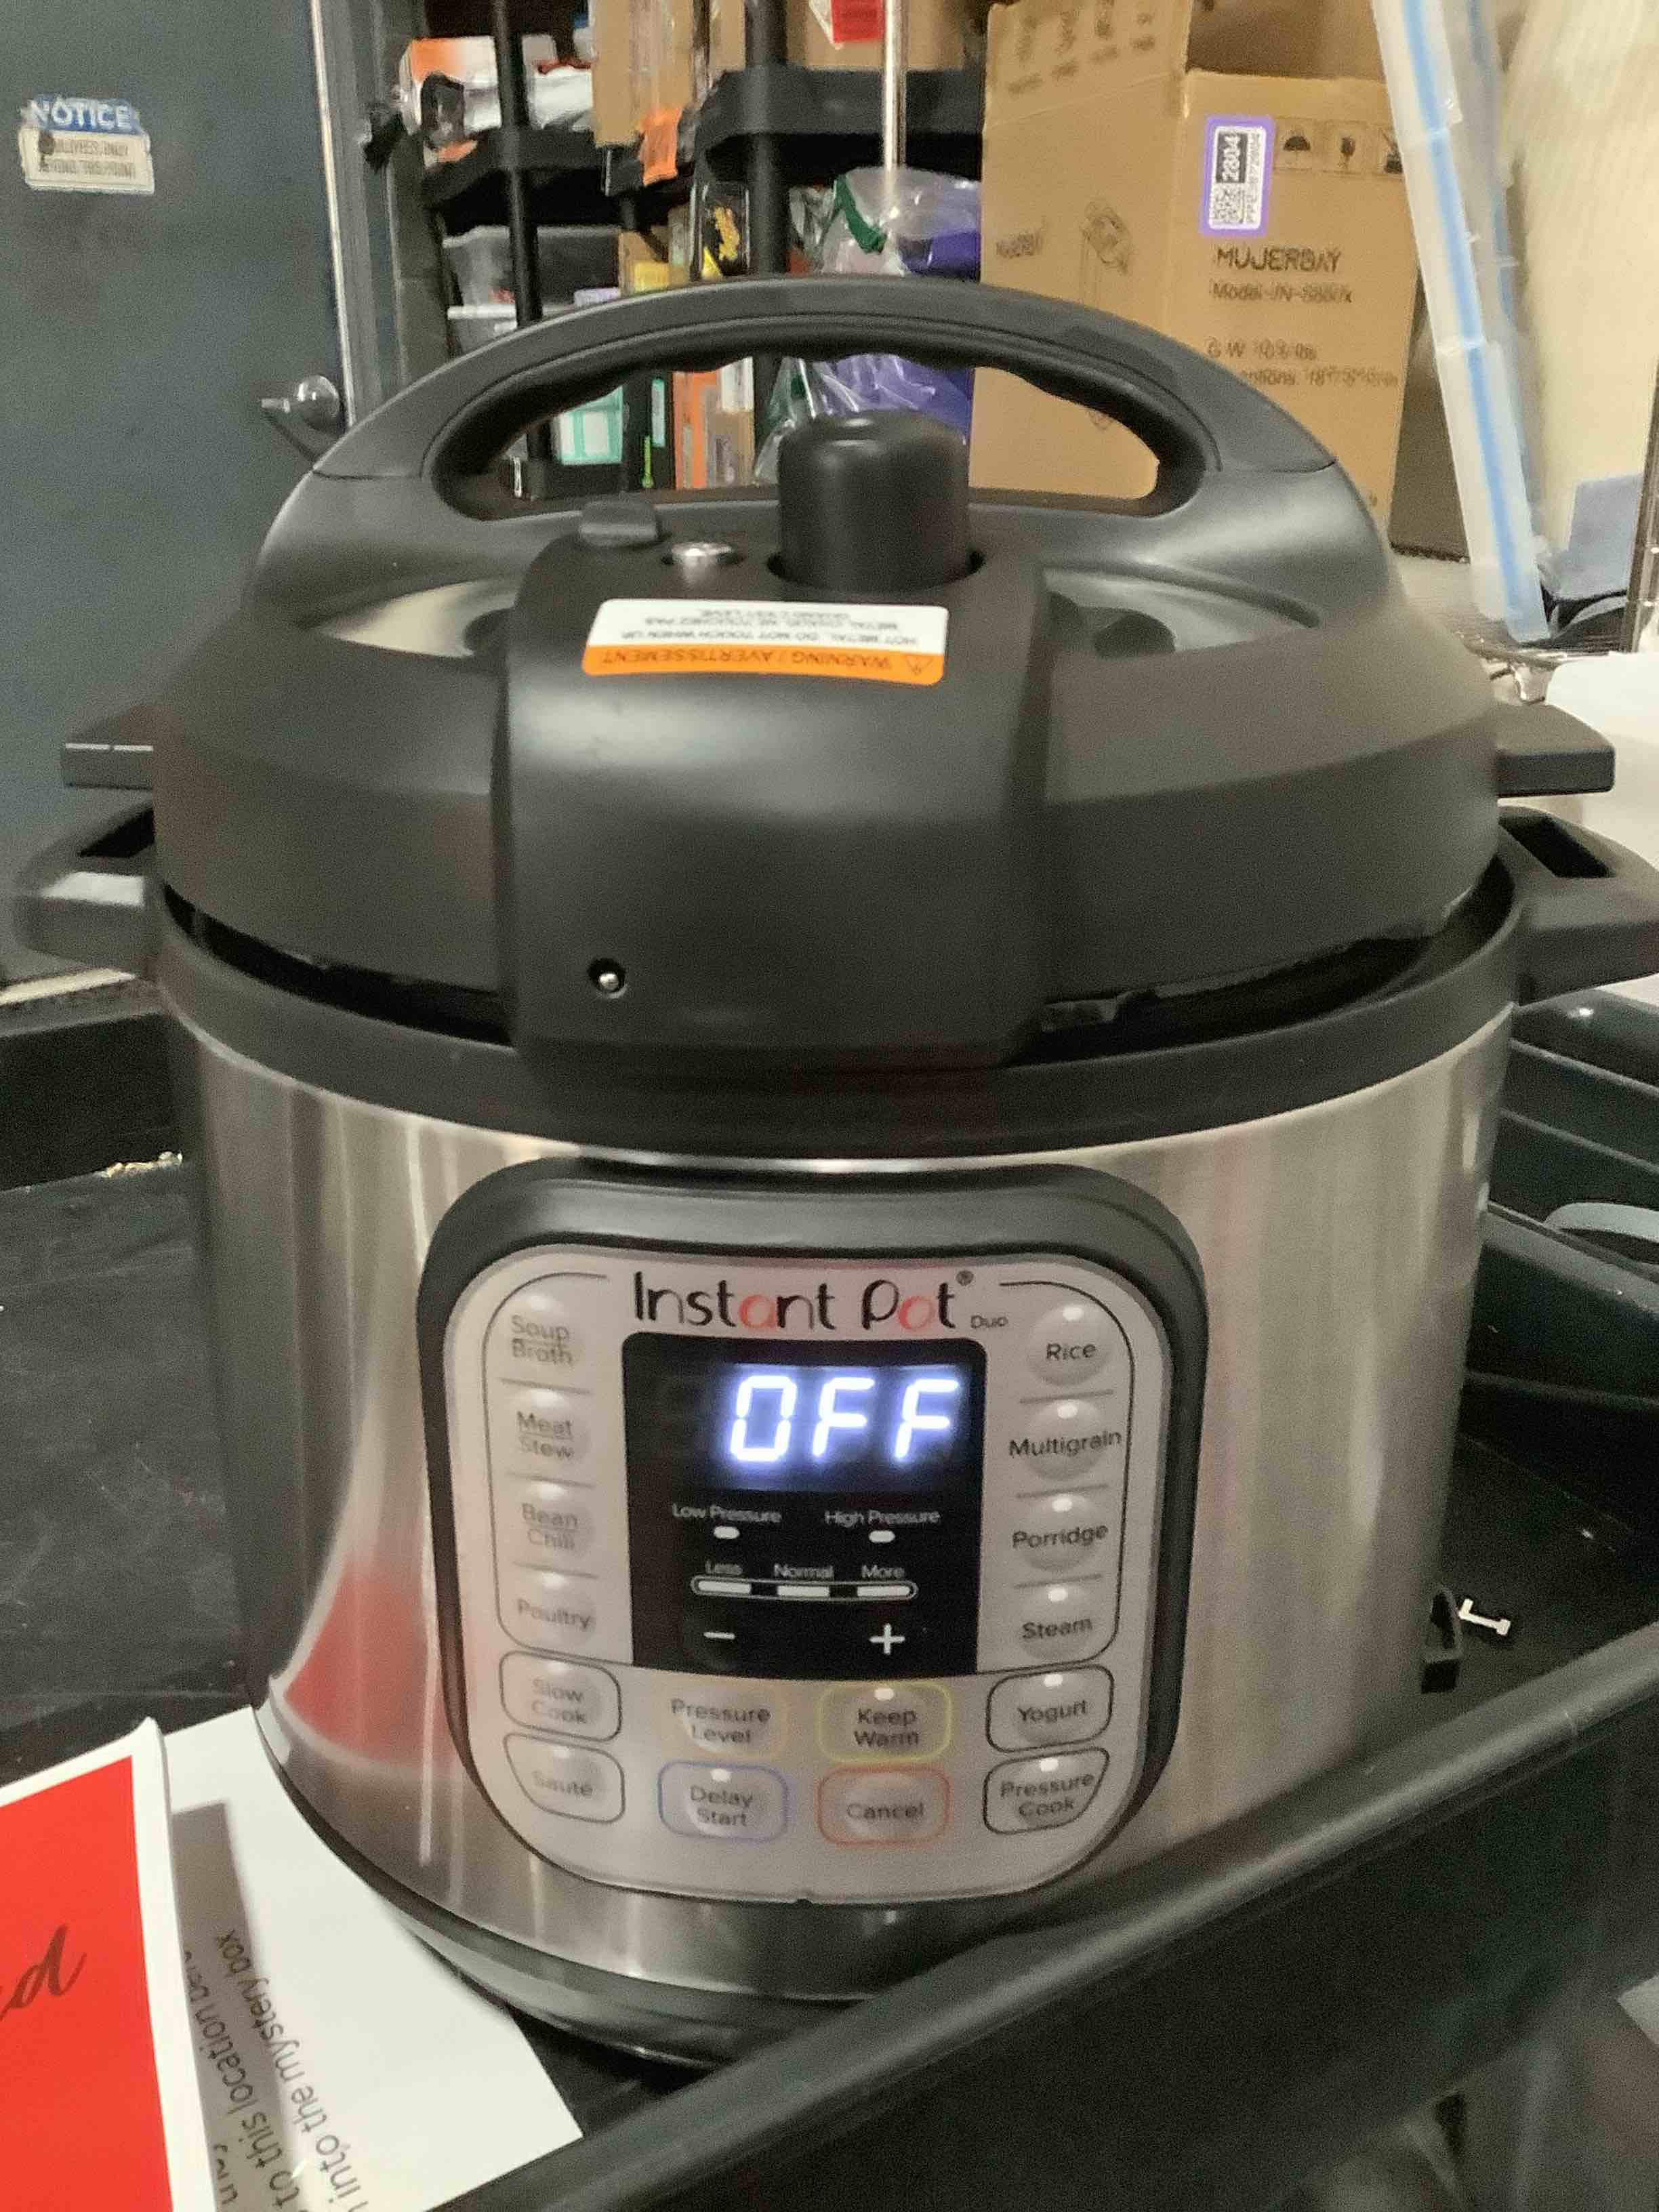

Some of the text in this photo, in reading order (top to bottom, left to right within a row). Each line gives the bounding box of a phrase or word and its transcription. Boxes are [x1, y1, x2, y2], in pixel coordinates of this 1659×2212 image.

[31, 100, 133, 130] NOTICE
[602, 648, 775, 664] AVERTISSEMENT
[790, 651, 891, 670] WARNING
[634, 1271, 836, 1329] Instant
[512, 1315, 571, 1342] Soup
[970, 1315, 1009, 1329] Duo
[512, 1338, 573, 1364] Broth
[1046, 1342, 1097, 1361] Rice
[517, 1411, 572, 1436] Meat
[729, 1374, 960, 1462] OFF
[519, 1436, 574, 1458] Stew
[1008, 1429, 1122, 1460] Multigrain
[522, 1502, 578, 1525] Bean
[673, 1504, 781, 1523] Low Pressure
[825, 1510, 940, 1527] High Pressure
[1012, 1524, 1109, 1551] Porridge
[774, 1563, 834, 1579] Normal
[861, 1564, 905, 1578] More
[518, 1599, 592, 1631] Poultry
[1022, 1618, 1093, 1639] Steam
[533, 1678, 583, 1702] Slow
[531, 1701, 586, 1724] Cook
[670, 1698, 772, 1723] Pressure
[857, 1708, 917, 1727] Keep
[1019, 1700, 1088, 1723] Yogurt
[692, 1725, 752, 1744] Level
[854, 1730, 919, 1748] Warm
[690, 1785, 754, 1809] Delay
[1000, 1774, 1095, 1798] Pressure
[697, 1808, 750, 1828] Start
[846, 1801, 925, 1821] Cancel
[1019, 1798, 1076, 1818] Cook
[216, 1929, 251, 1978] box
[237, 1976, 305, 2083] mystery
[196, 2001, 260, 2115] location
[291, 2085, 327, 2133] the
[237, 2111, 283, 2169] this
[315, 2135, 361, 2203] into
[268, 2170, 300, 2208] to
